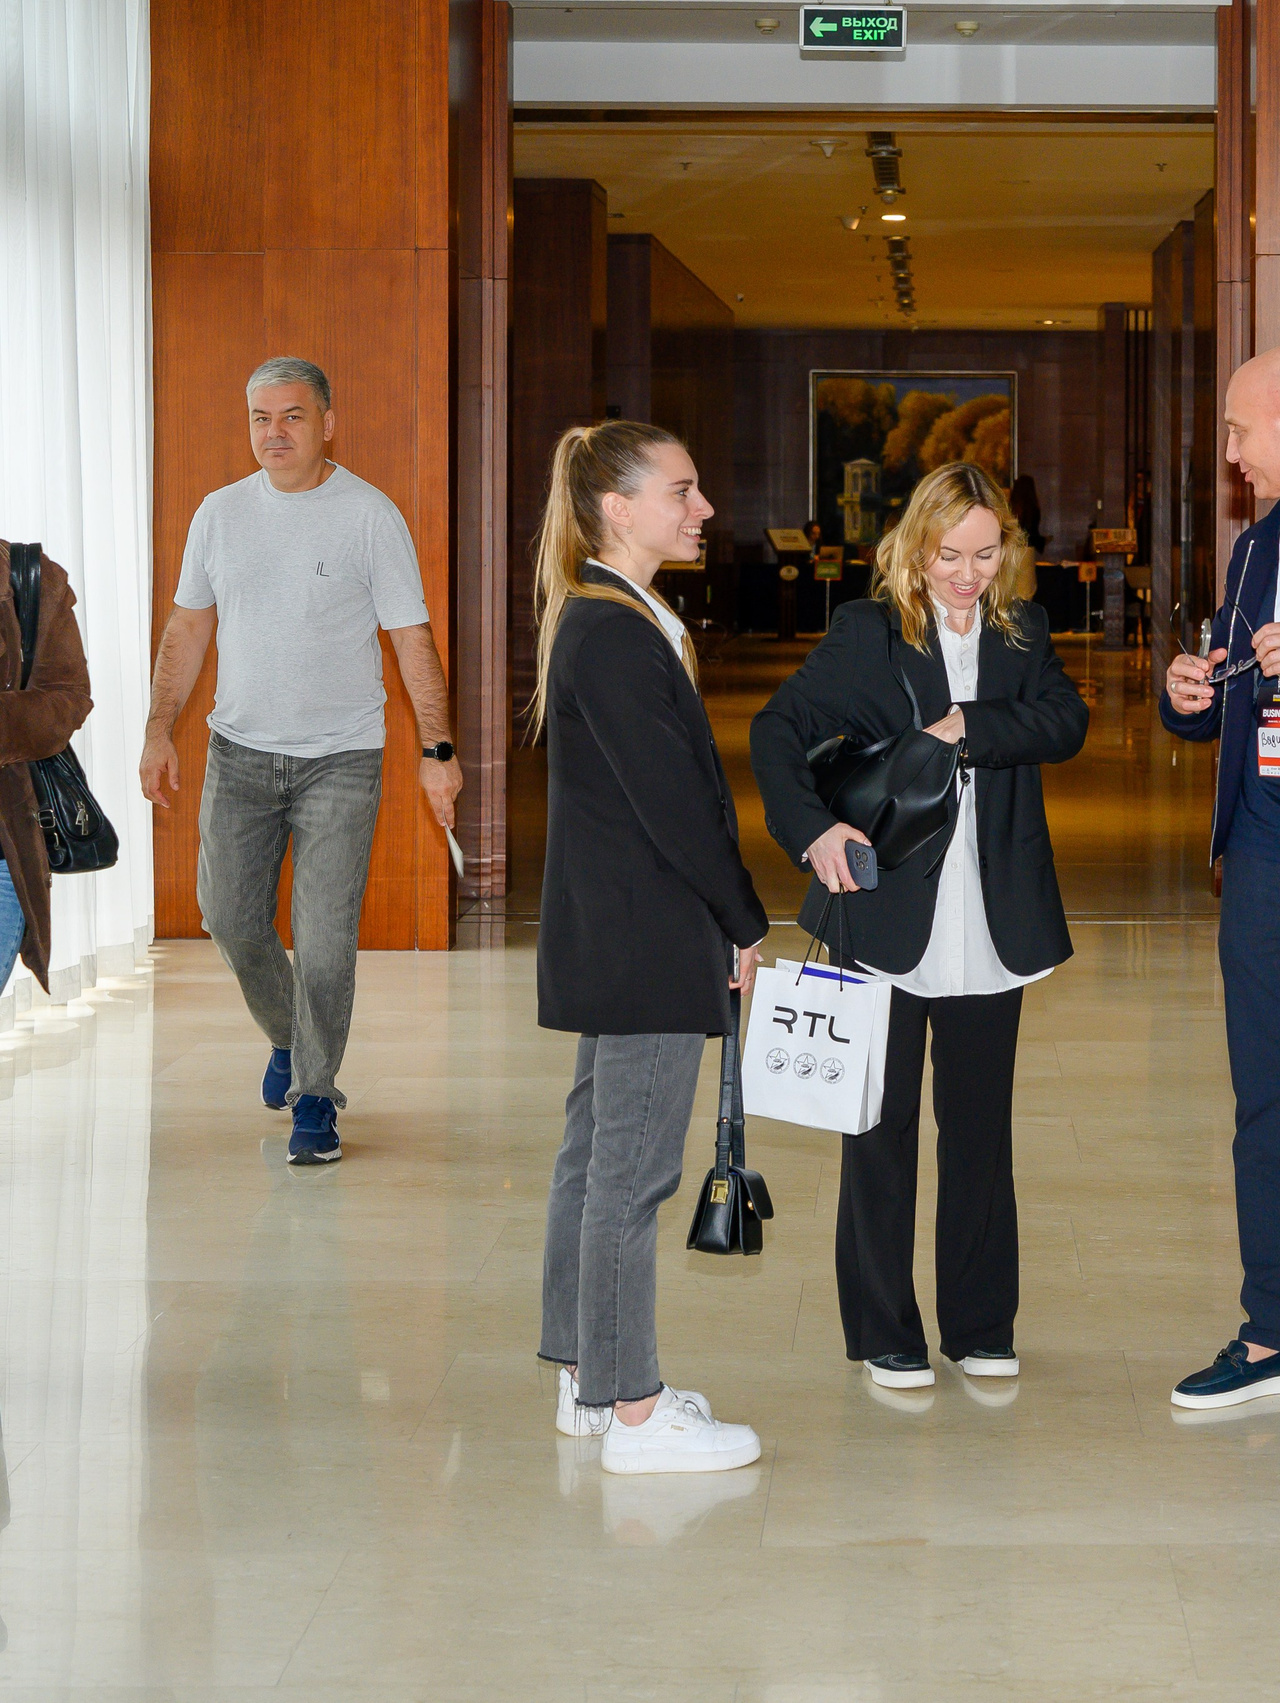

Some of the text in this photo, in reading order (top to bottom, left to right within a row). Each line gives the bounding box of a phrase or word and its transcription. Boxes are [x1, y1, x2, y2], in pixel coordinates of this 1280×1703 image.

[841, 17, 898, 31] ВЫХОД
[853, 29, 887, 40] EXIT
[772, 1005, 850, 1044] RTL
